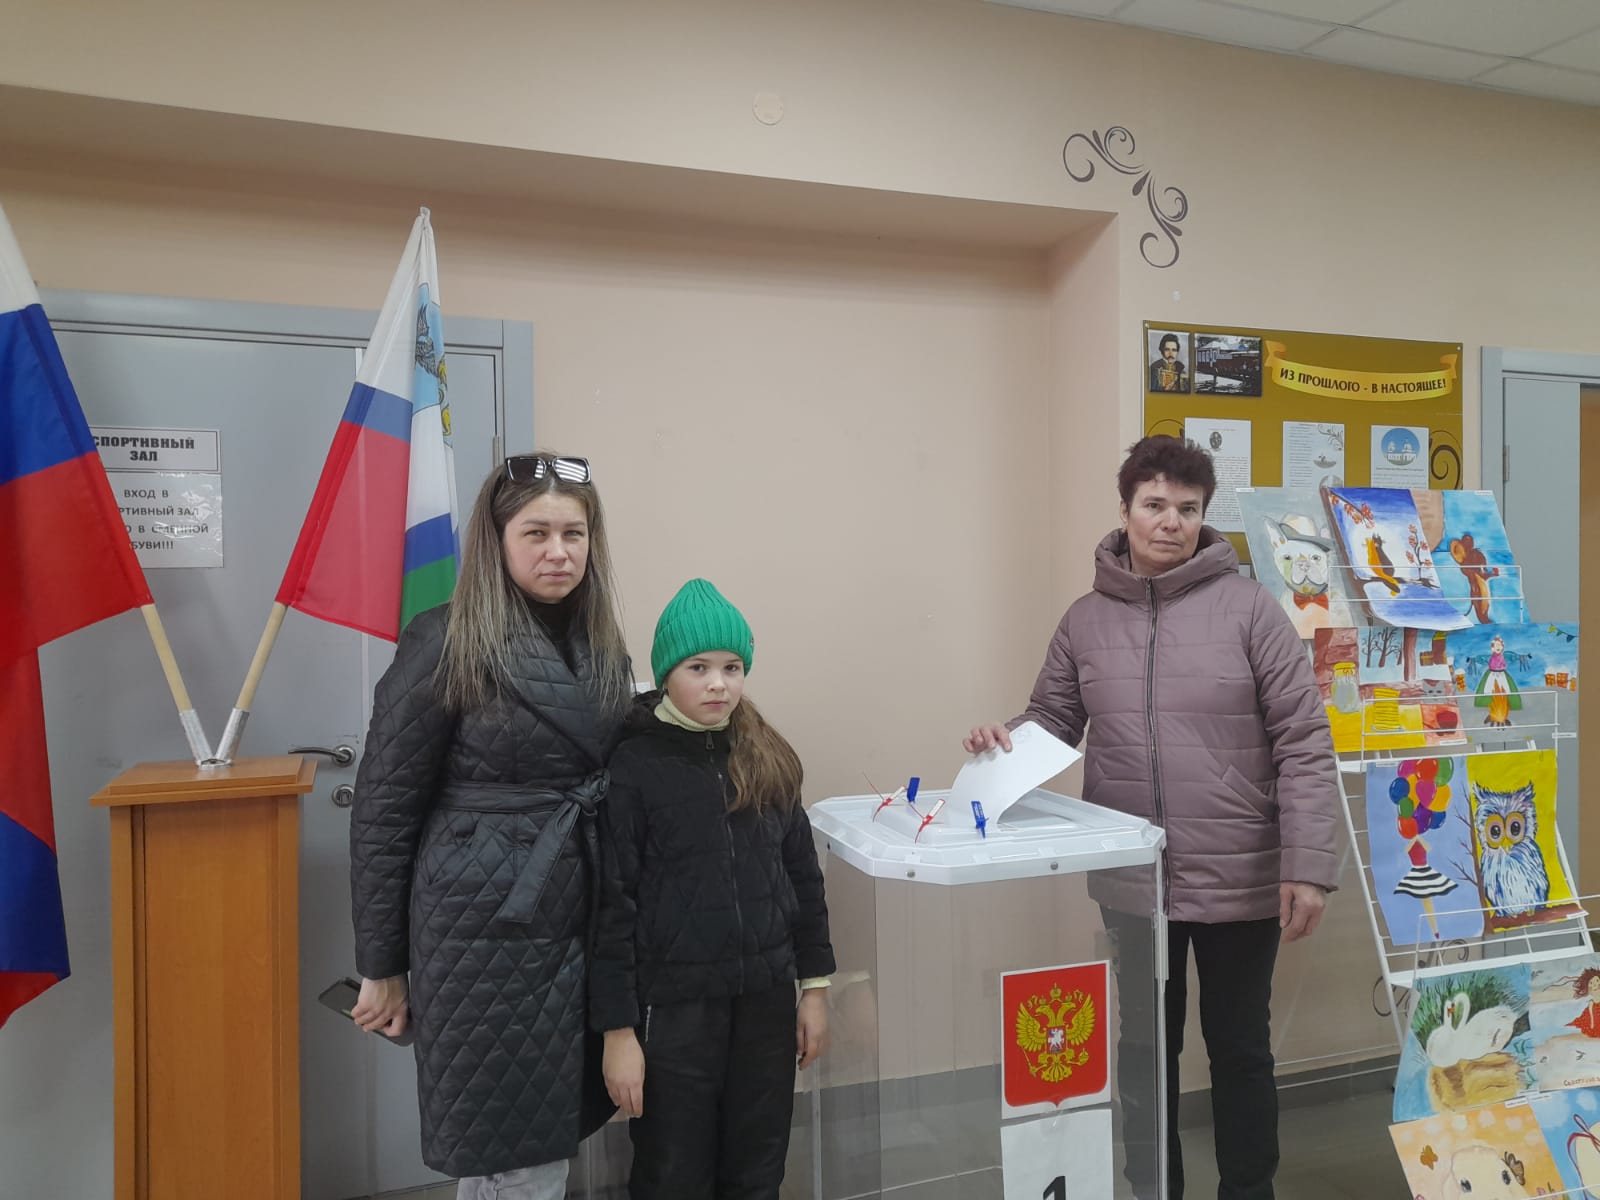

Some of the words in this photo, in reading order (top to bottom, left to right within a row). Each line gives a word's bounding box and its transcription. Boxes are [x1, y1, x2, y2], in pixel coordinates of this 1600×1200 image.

[1280, 367, 1295, 380] ИЗ
[1298, 372, 1360, 392] ПРОШЛОГО
[1371, 383, 1378, 393] В
[129, 450, 158, 462] ЗАЛ
[124, 489, 156, 500] ВХОД
[162, 490, 169, 498] В
[118, 506, 174, 516] РТИВНЫЙ
[177, 507, 199, 516] ЗАЛ
[138, 525, 145, 533] В
[130, 541, 174, 550] БУВИ!!!
